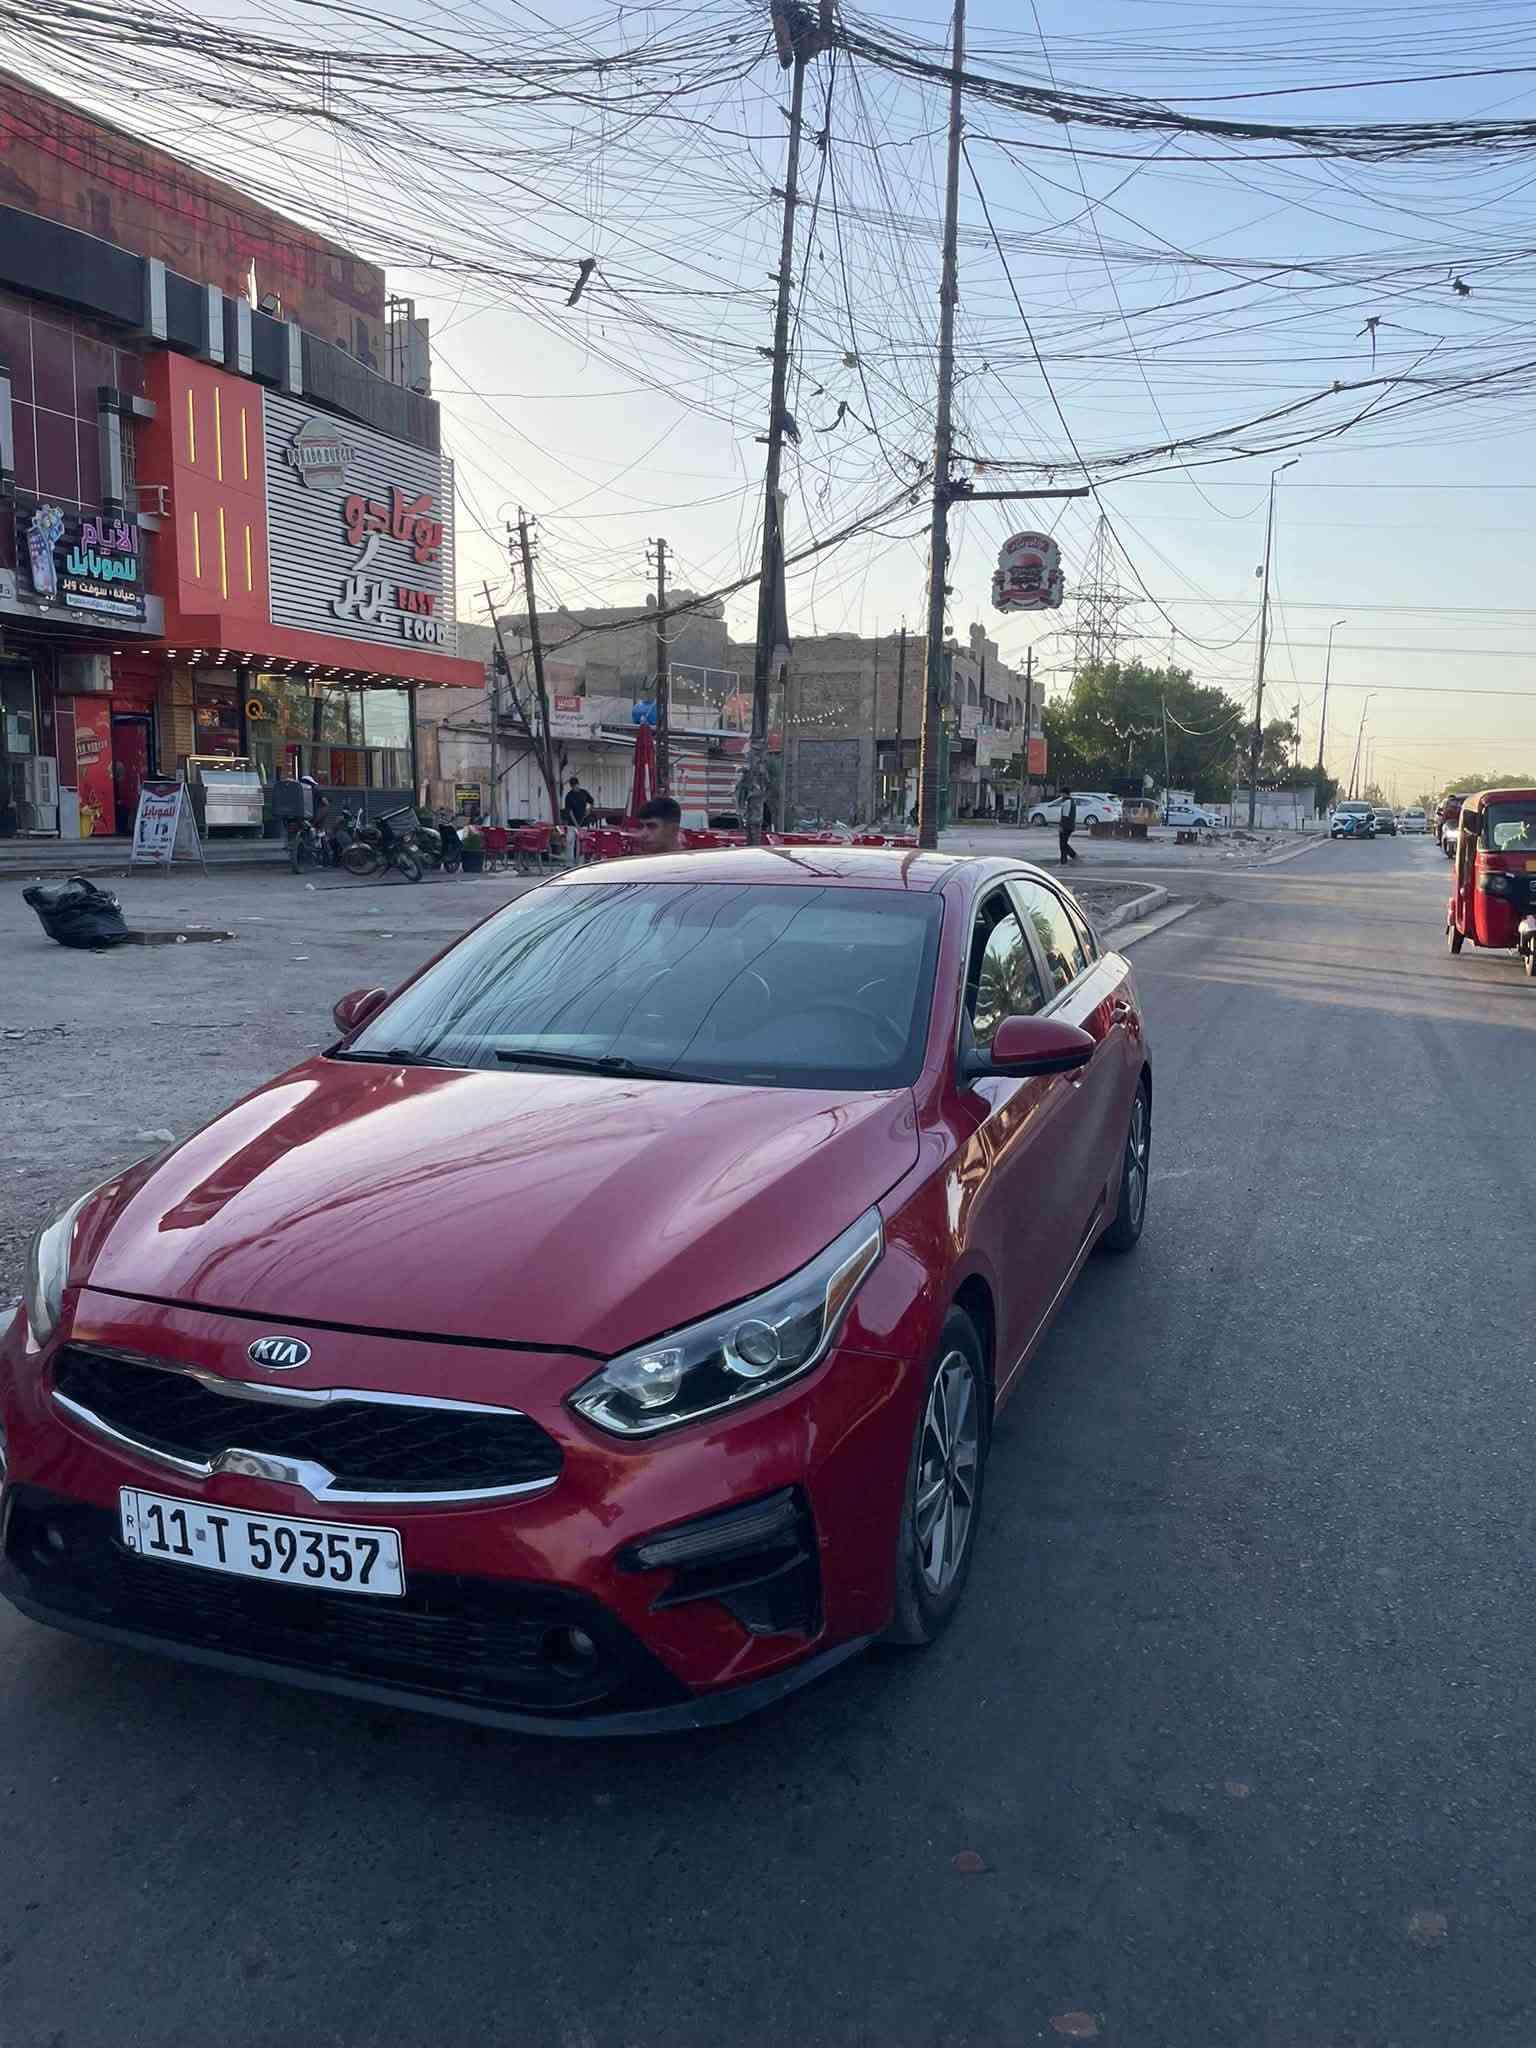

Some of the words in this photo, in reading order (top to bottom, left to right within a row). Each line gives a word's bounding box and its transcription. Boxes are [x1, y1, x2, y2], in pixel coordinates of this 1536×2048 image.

[81, 516, 139, 555] الأيام
[66, 546, 137, 582] للموبايل
[398, 586, 436, 617] EASY
[402, 617, 447, 646] FOOD
[254, 1340, 298, 1363] KIA
[147, 1503, 193, 1557] 11
[207, 1515, 230, 1563] T
[247, 1521, 381, 1585] 59357
